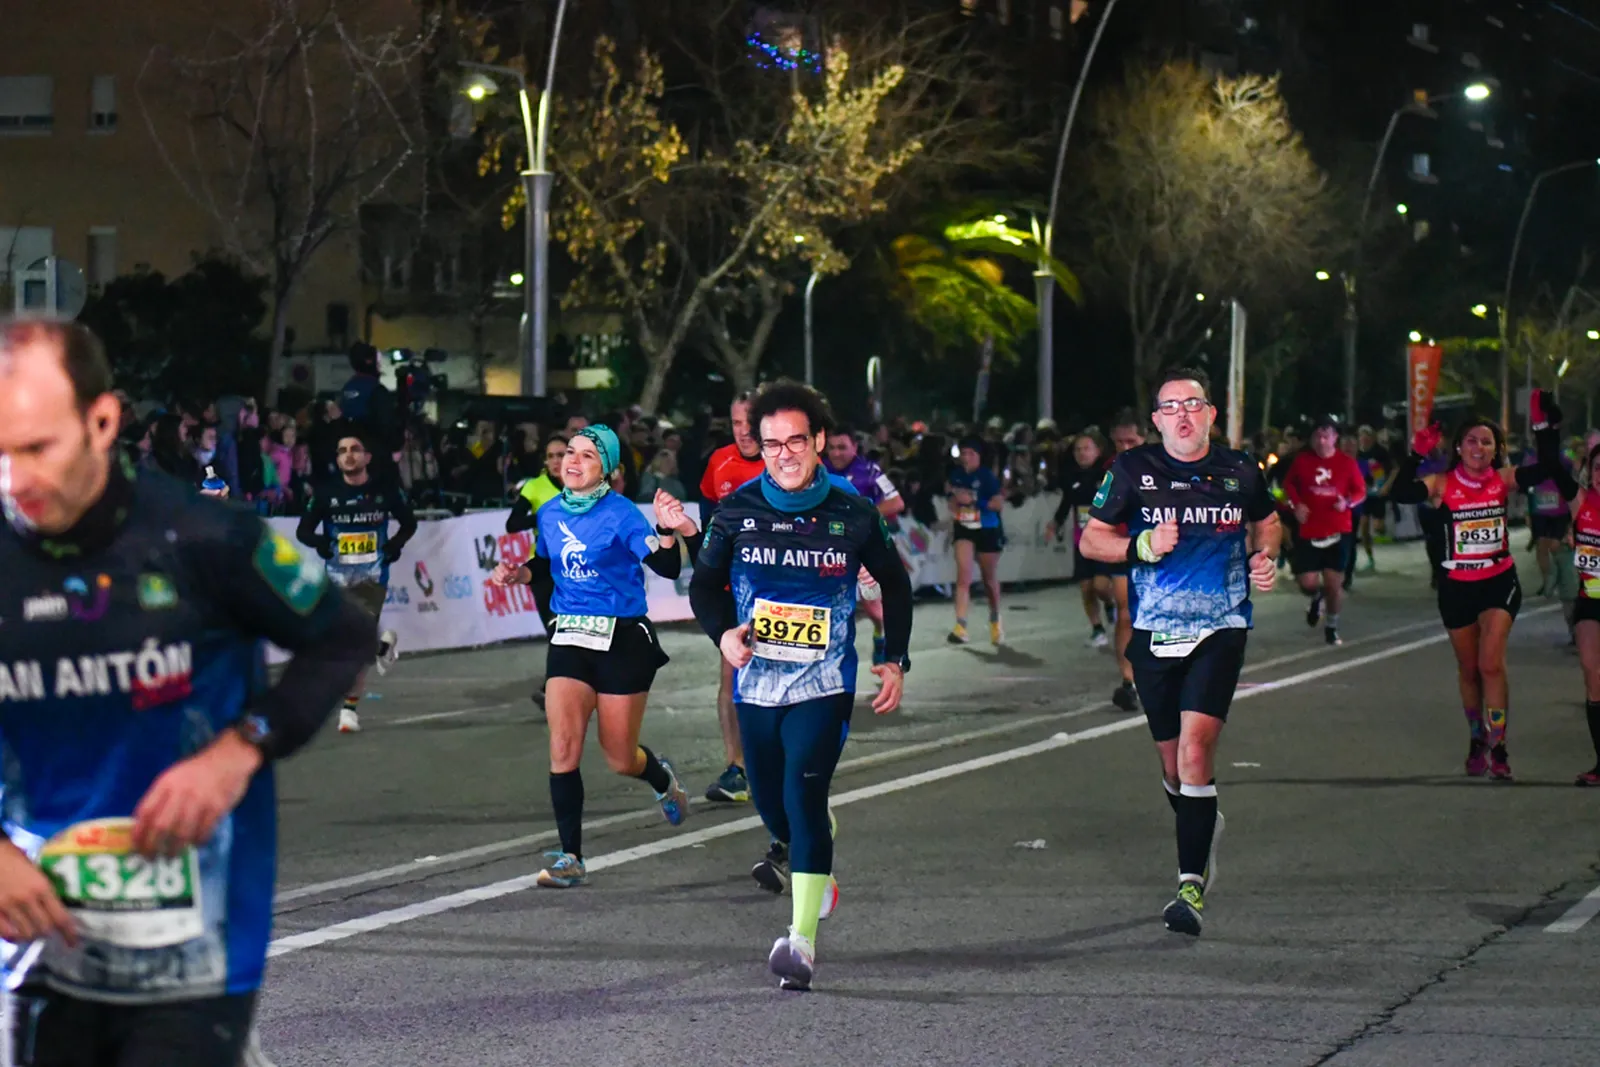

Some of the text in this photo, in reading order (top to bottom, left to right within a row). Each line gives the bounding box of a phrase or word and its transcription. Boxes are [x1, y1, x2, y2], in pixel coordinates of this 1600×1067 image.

[1141, 503, 1242, 524] SAN ANTÓN
[1460, 528, 1500, 541] 9631
[741, 547, 847, 567] SAN ANTÓN
[1578, 555, 1600, 568] 95
[560, 614, 609, 632] 2339
[757, 617, 822, 643] 3976
[55, 637, 192, 698] ANTÓN
[53, 854, 186, 900] 1328
